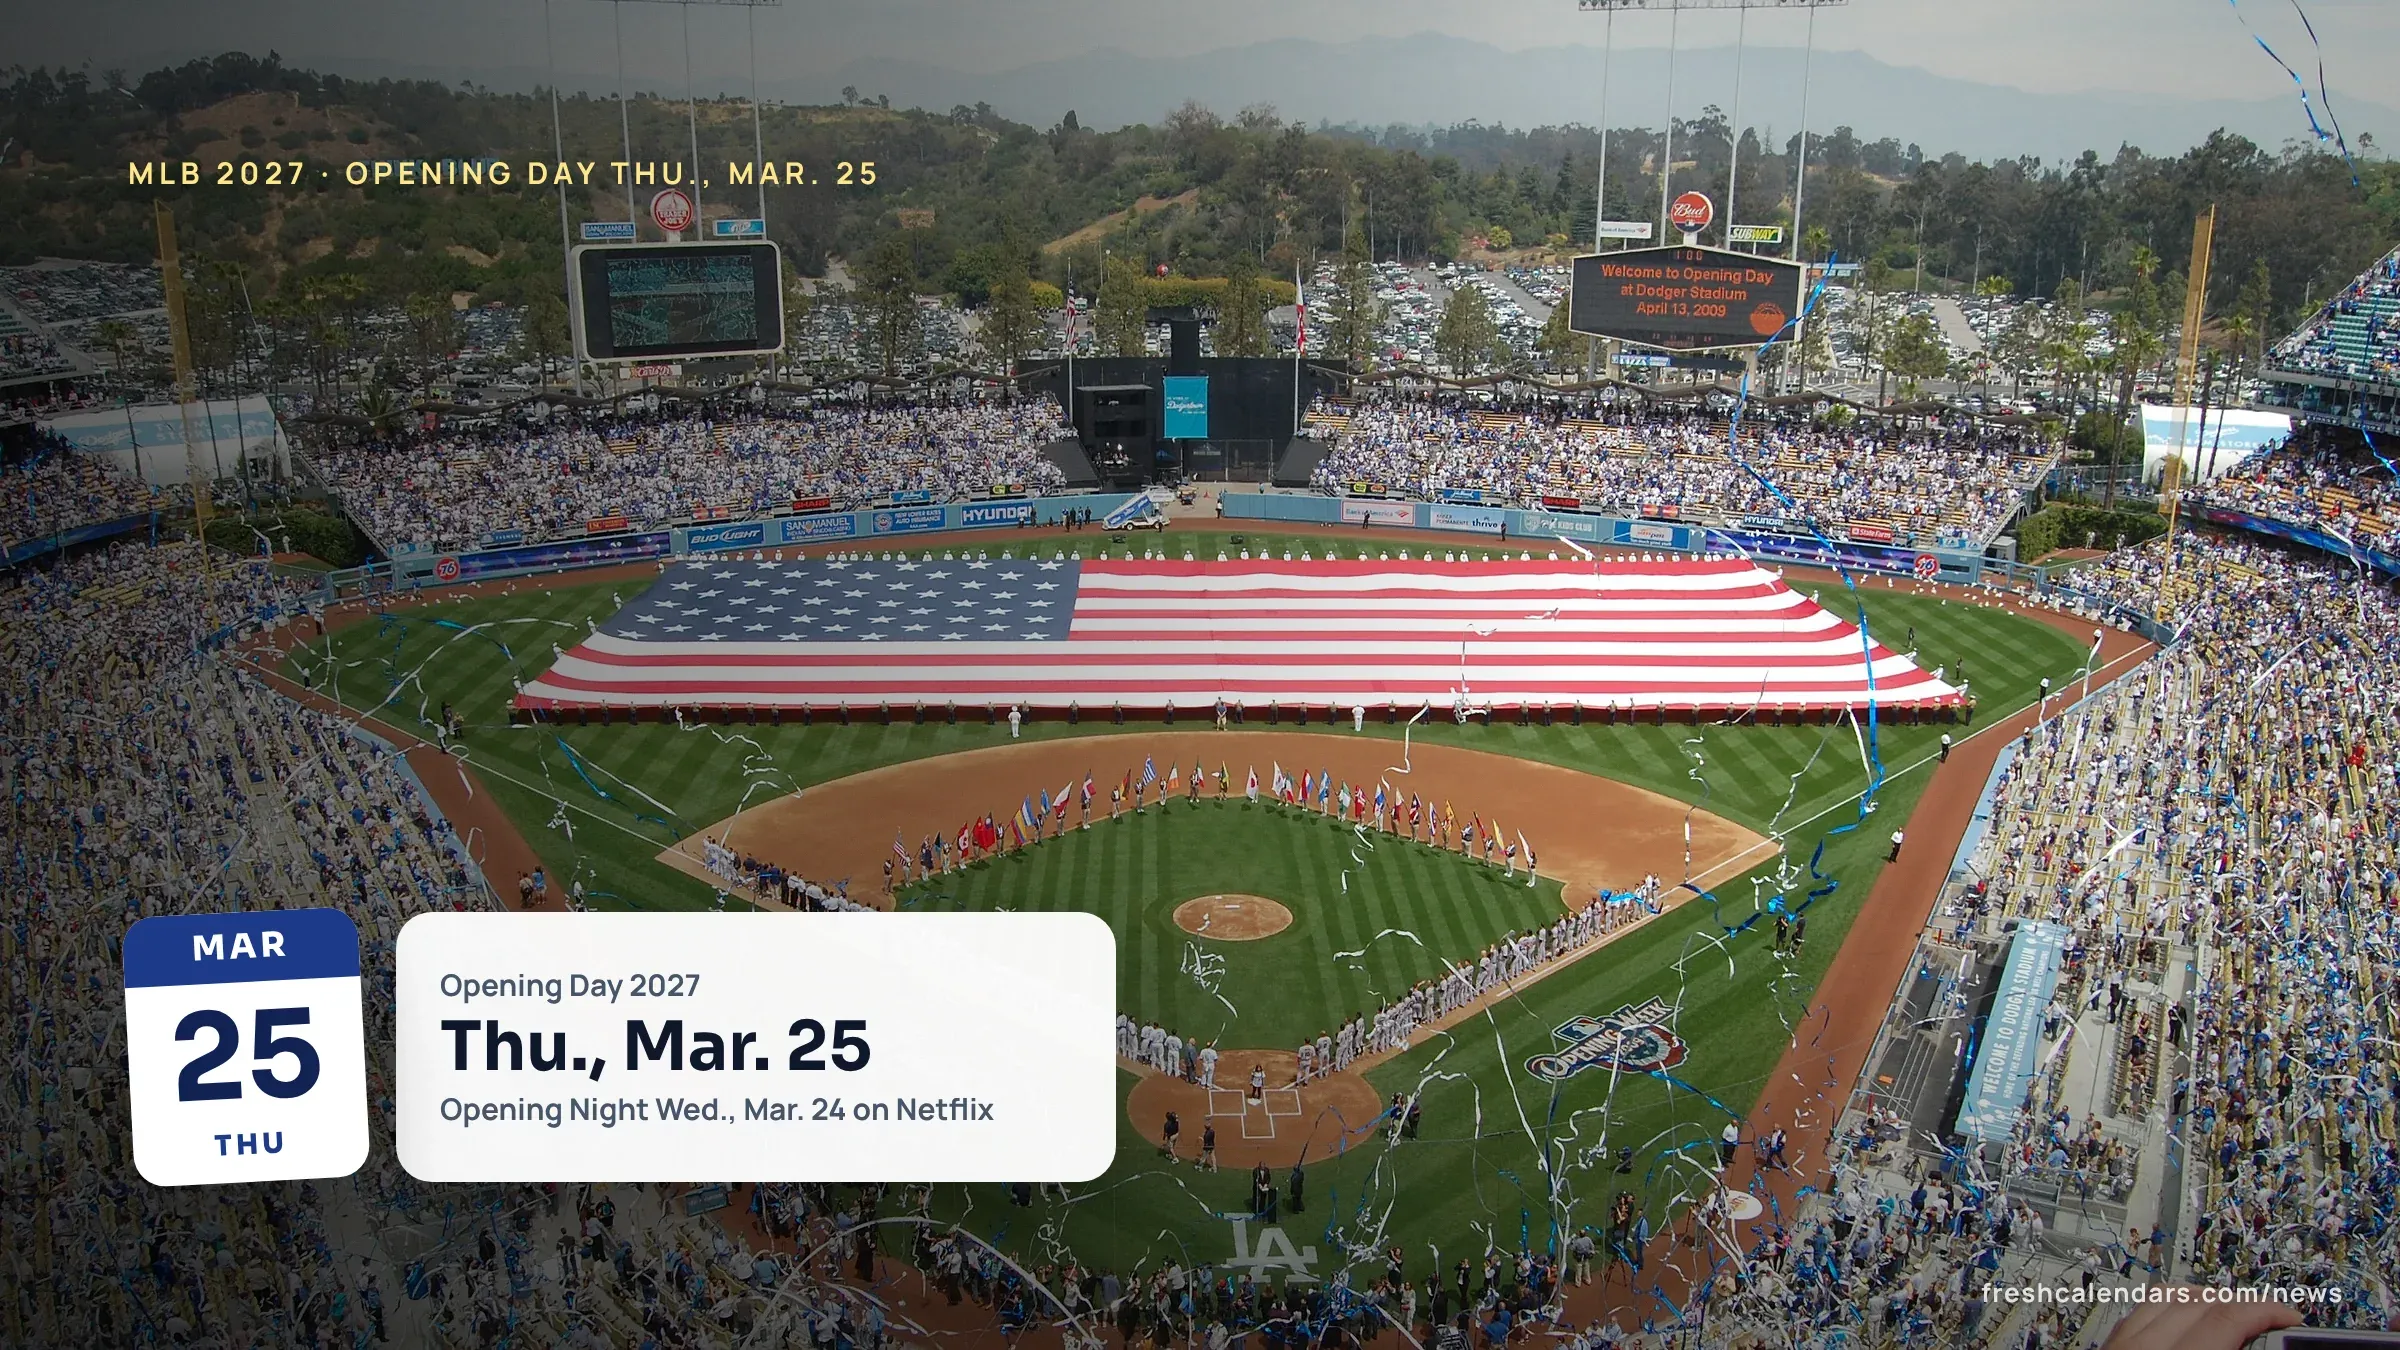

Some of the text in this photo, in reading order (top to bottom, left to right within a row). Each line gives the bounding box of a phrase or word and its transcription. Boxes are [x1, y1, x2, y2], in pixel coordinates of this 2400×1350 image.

[658, 210, 688, 218] TRADER
[1674, 203, 1707, 216] Bud
[1730, 228, 1775, 240] SUBWAY
[1601, 264, 1774, 286] Welcome to Opening Day
[1620, 284, 1747, 300] at Dodger Stadium
[1636, 301, 1727, 317] April 13, 2009
[793, 499, 829, 509] SHARP
[962, 505, 1033, 522] HYUNDAI
[1744, 515, 1784, 527] HYUNDAI
[786, 516, 850, 531] SAN MANUEL
[1472, 518, 1498, 528] thrive
[1557, 520, 1575, 530] KIDS
[1575, 522, 1593, 532] CLUB
[691, 529, 761, 544] BUD LIGHT
[440, 561, 457, 576] 76
[1602, 1001, 1673, 1029] WEEK
[1982, 946, 2037, 1095] WELCOME TO DODGER STADIUM
[1531, 1029, 1624, 1077] OPENING
[1223, 1212, 1321, 1284] LA
